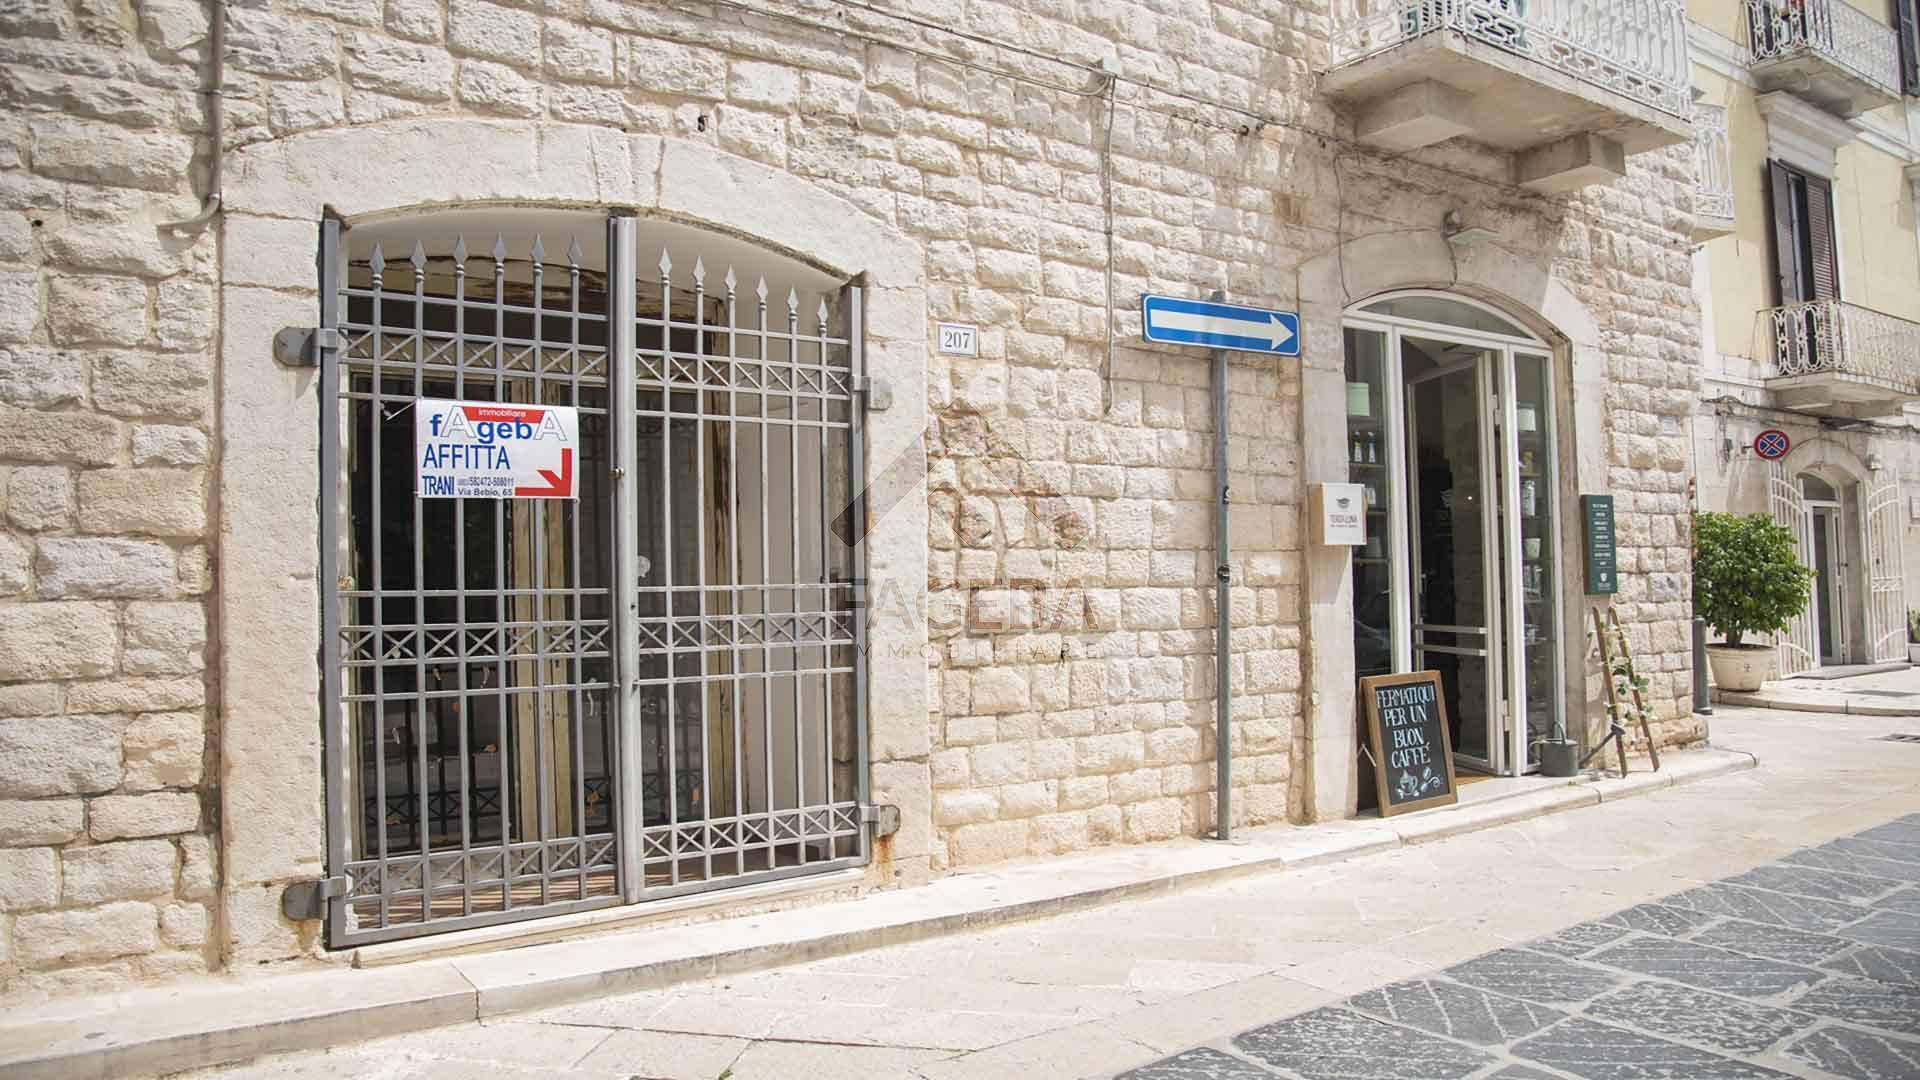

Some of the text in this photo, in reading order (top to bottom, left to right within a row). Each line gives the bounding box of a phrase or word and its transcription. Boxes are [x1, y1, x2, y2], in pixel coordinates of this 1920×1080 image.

[944, 331, 970, 348] 207
[423, 444, 511, 470] AFFITTA
[422, 475, 455, 496] TRANI
[458, 487, 472, 496] Via
[502, 488, 513, 496] 65
[1384, 704, 1427, 727] PER UN
[1393, 728, 1425, 748] BUON
